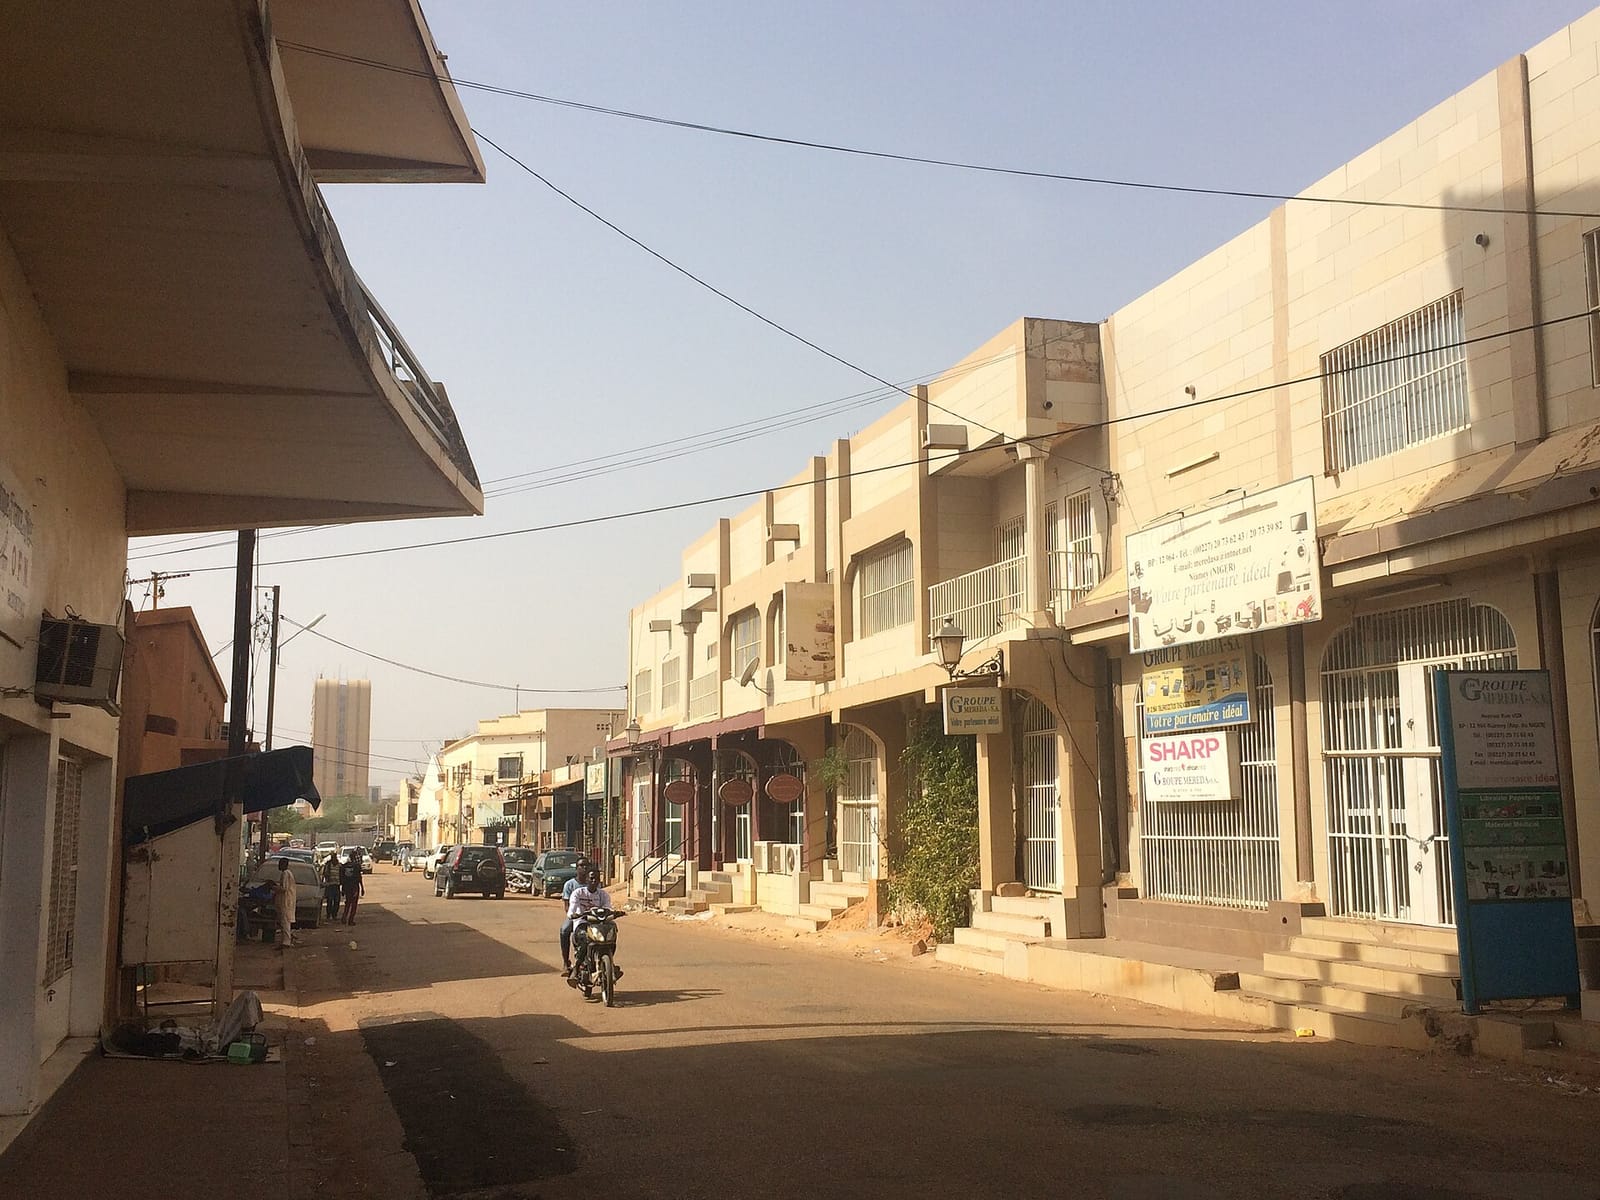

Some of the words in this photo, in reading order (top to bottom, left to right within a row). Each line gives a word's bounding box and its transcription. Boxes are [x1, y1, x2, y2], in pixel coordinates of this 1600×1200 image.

[1182, 573, 1240, 606] partenaire
[1460, 678, 1528, 701] GROUPE
[950, 695, 996, 714] GROUPE
[1150, 714, 1174, 729] Votre
[1173, 709, 1220, 730] partenaire
[1222, 703, 1243, 720] idéal
[1149, 738, 1220, 762] SHARP
